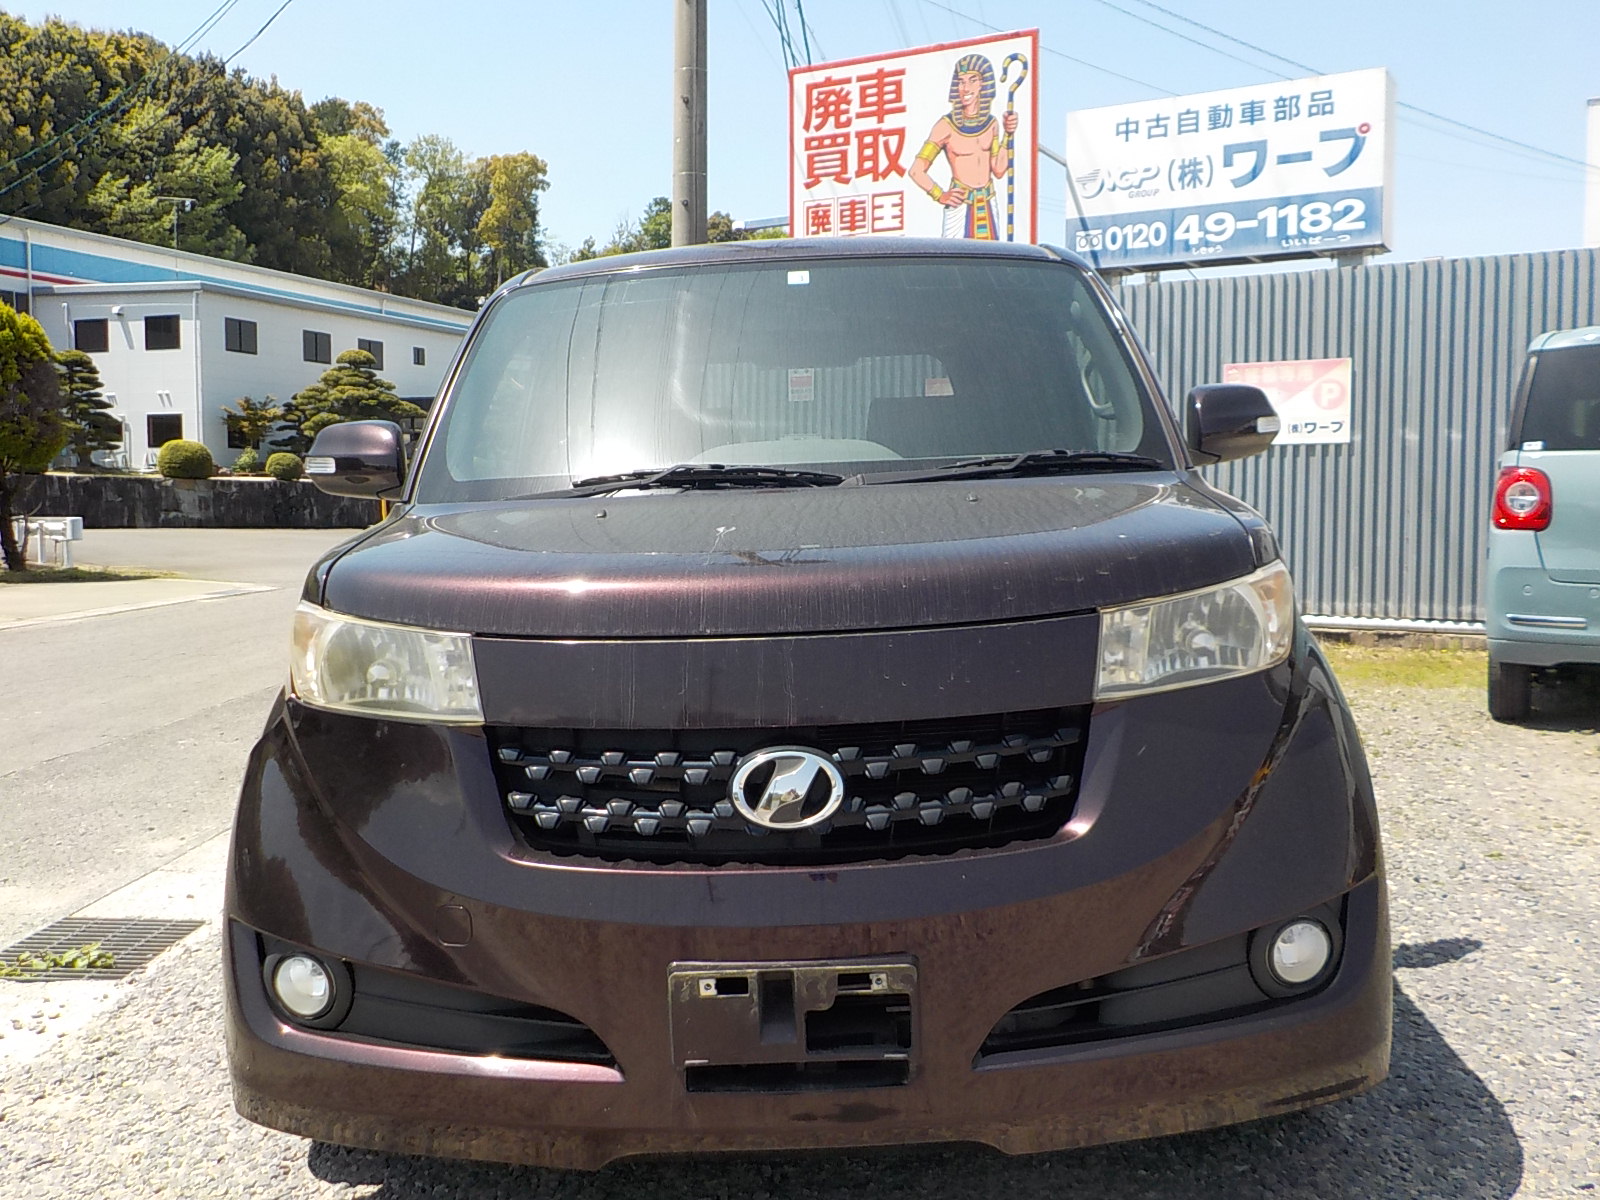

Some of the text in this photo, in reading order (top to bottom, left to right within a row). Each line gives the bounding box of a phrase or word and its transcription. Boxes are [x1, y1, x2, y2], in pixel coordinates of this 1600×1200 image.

[803, 67, 907, 133] 廃車
[1115, 89, 1335, 142] 中古自動車部品
[803, 126, 907, 190] 買取
[803, 190, 905, 236] 廃車王
[1128, 188, 1160, 198] GROUP
[1104, 198, 1366, 250] 0120 49-1182
